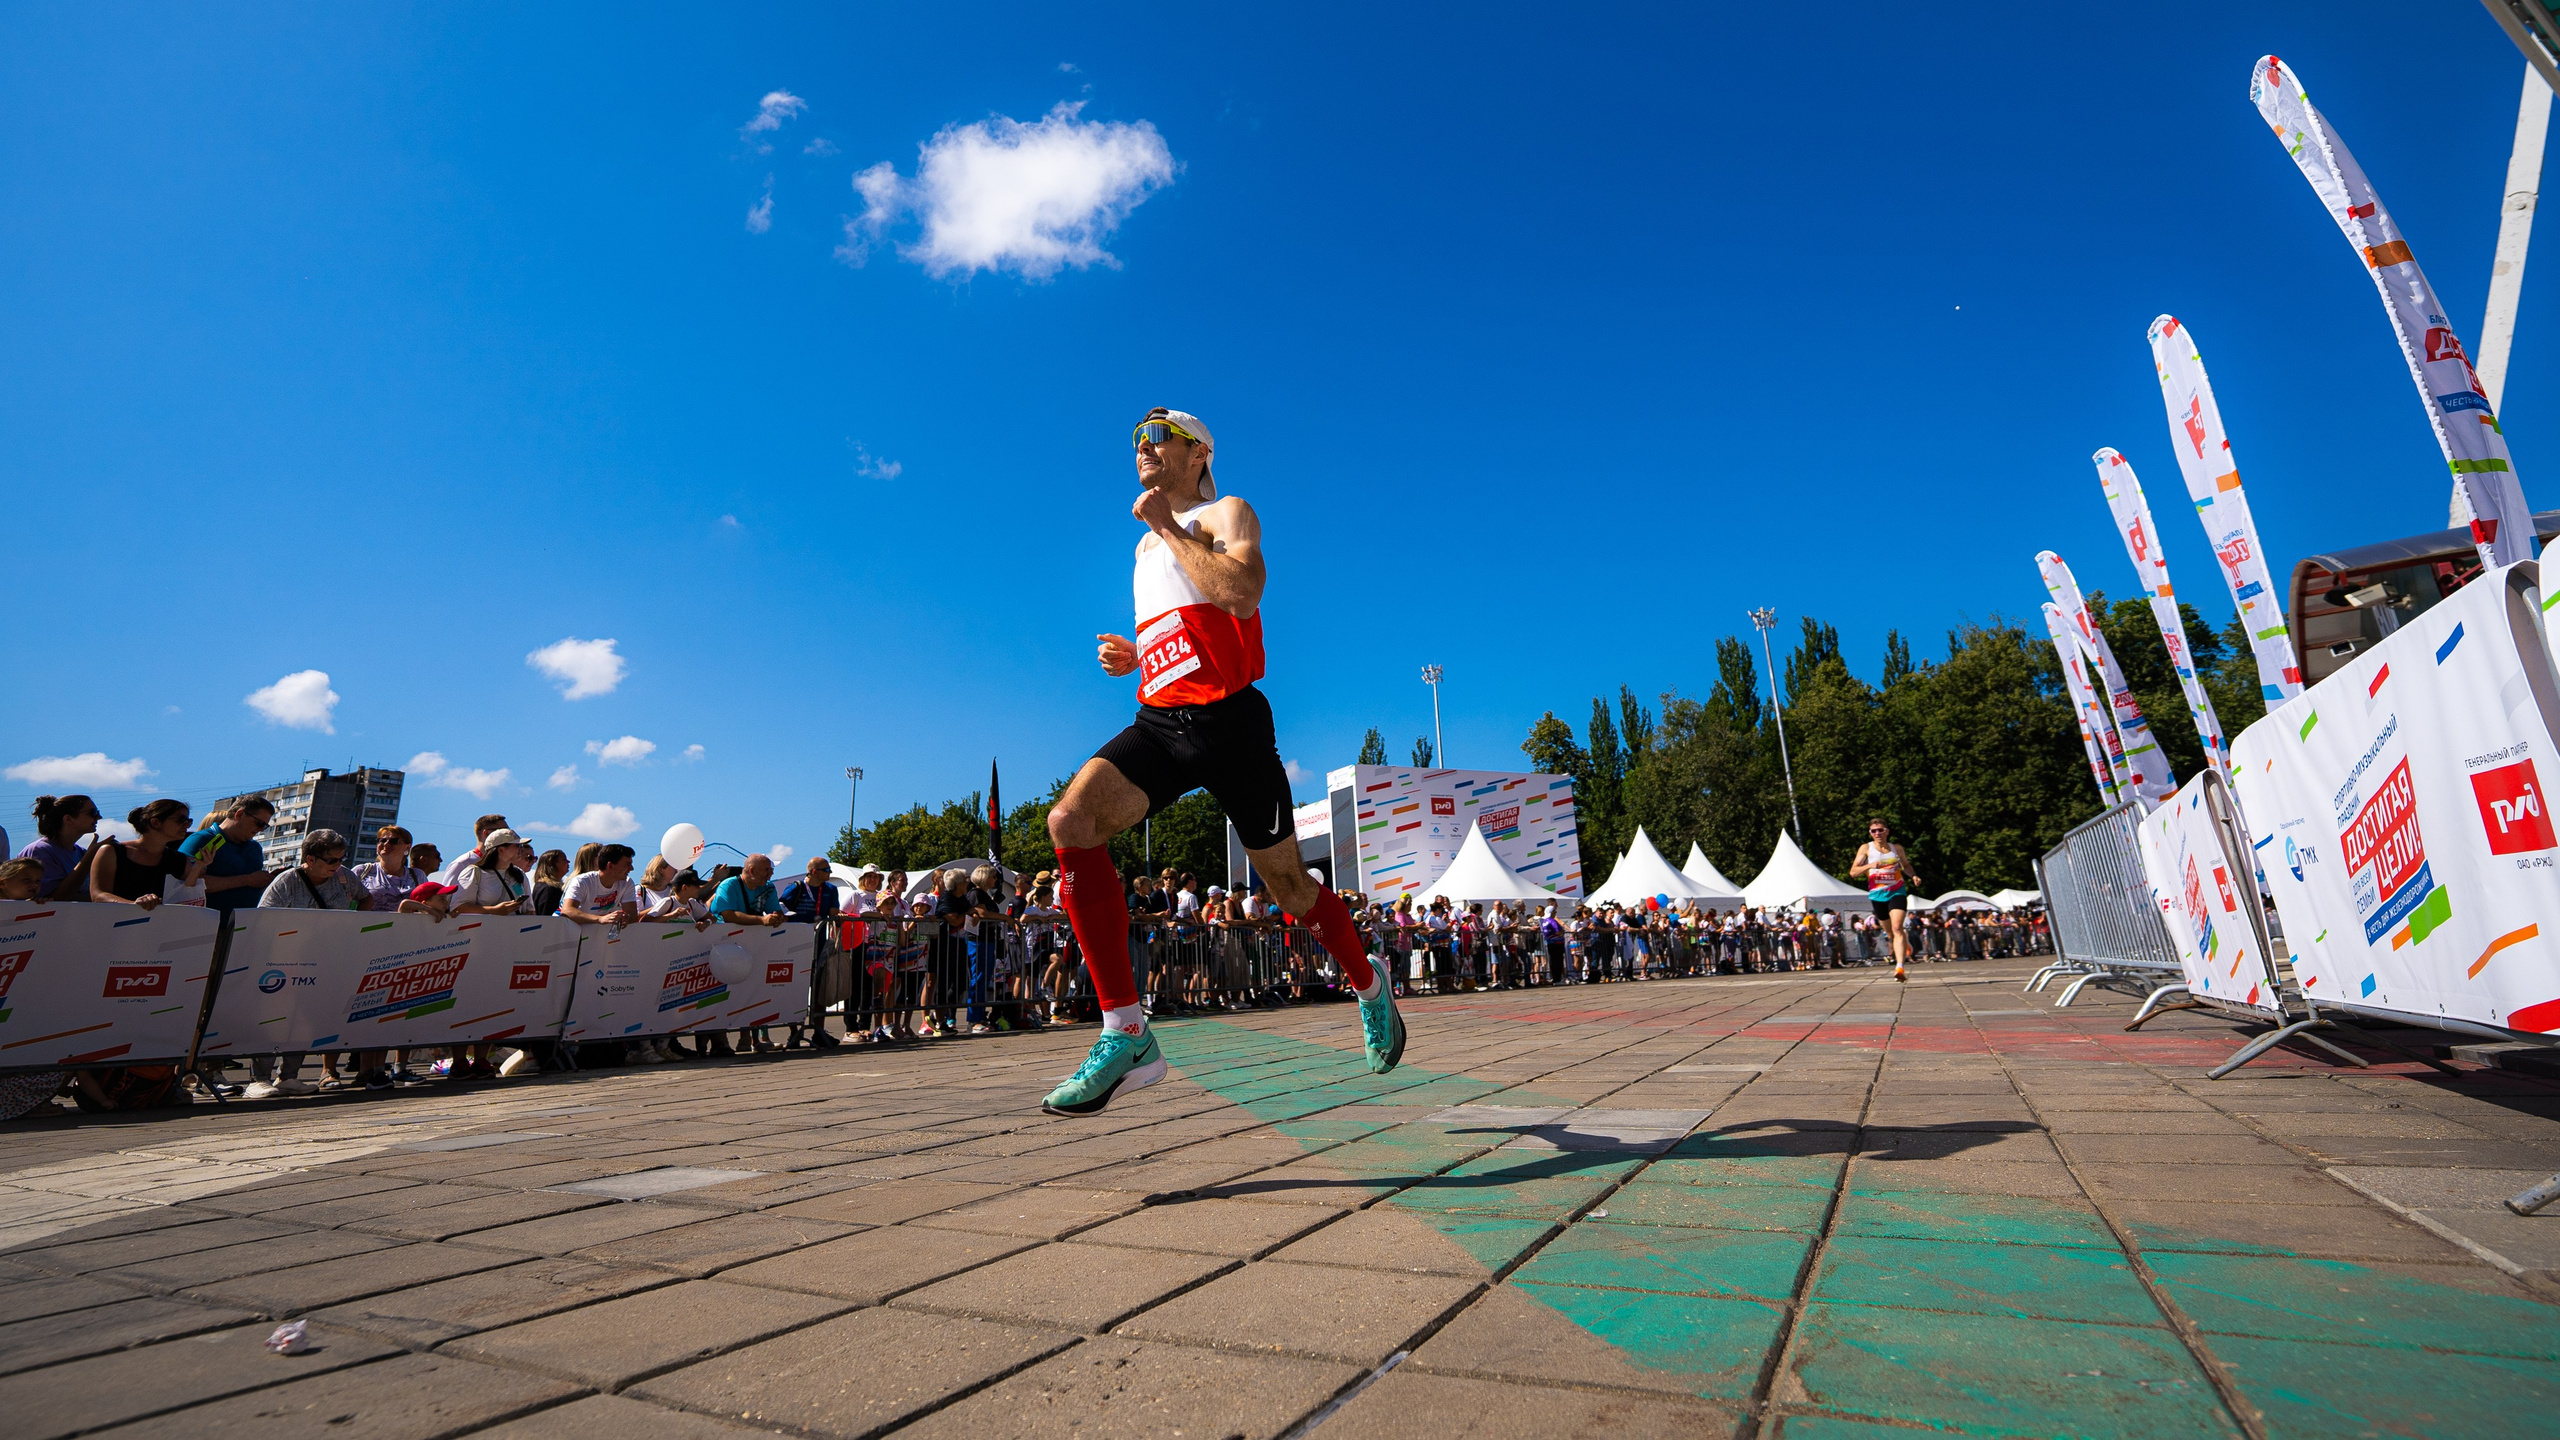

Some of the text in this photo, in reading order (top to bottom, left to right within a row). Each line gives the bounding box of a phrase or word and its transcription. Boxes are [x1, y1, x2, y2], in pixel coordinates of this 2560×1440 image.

[1147, 636, 1192, 674] 3124
[2464, 747, 2510, 769] ГЕНЕРАЛЬНЫЙ
[1480, 808, 1518, 825] ДОСТИГАЯ
[1494, 816, 1517, 830] ЦЕЛИ!
[2346, 767, 2413, 874] ДОСТИГАЯ
[2376, 812, 2422, 889] ЦЕЛИ!
[2516, 858, 2531, 870] ОАО
[2360, 868, 2372, 888] ВСЕЙ
[2356, 886, 2377, 915] СЕМЬИ
[370, 938, 471, 965] СПОРТИВНО-МУЗЫКАЛЬНЫЙ
[362, 957, 461, 992] ДОСТИГАЯ
[366, 960, 407, 973] ПРАЗДНИК
[667, 964, 712, 988] ДОСТИ
[354, 990, 386, 1002] ДЛЯ ВСЕЙ
[393, 972, 454, 999] ЦЕЛИ!
[610, 985, 635, 993] Sobytie
[351, 997, 383, 1010] СЕМЬИ
